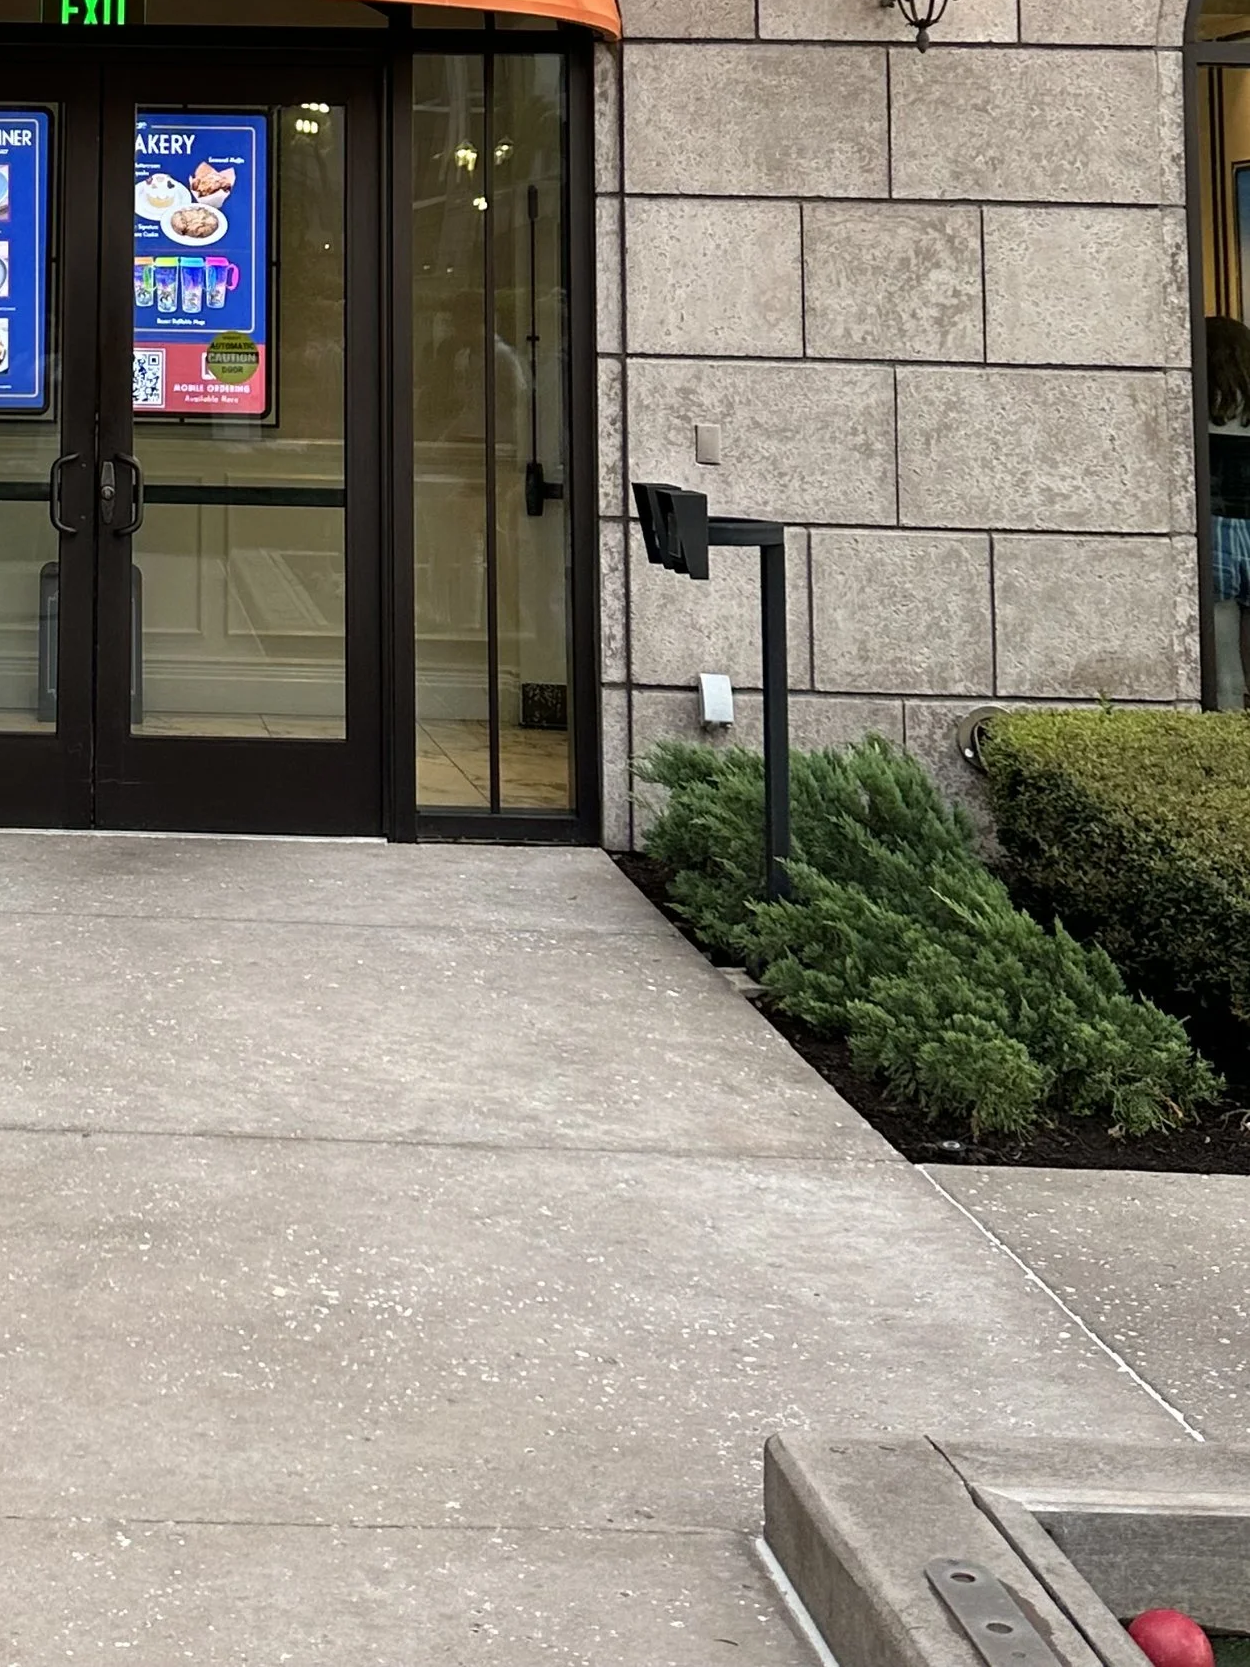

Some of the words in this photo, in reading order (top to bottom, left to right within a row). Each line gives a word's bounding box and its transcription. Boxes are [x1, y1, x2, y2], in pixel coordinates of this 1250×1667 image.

[135, 134, 195, 154] AKERY
[211, 342, 255, 350] AUTOMATIC
[208, 353, 256, 362] CAUTION
[173, 383, 204, 392] MOBILE
[206, 384, 250, 393] ORDERING
